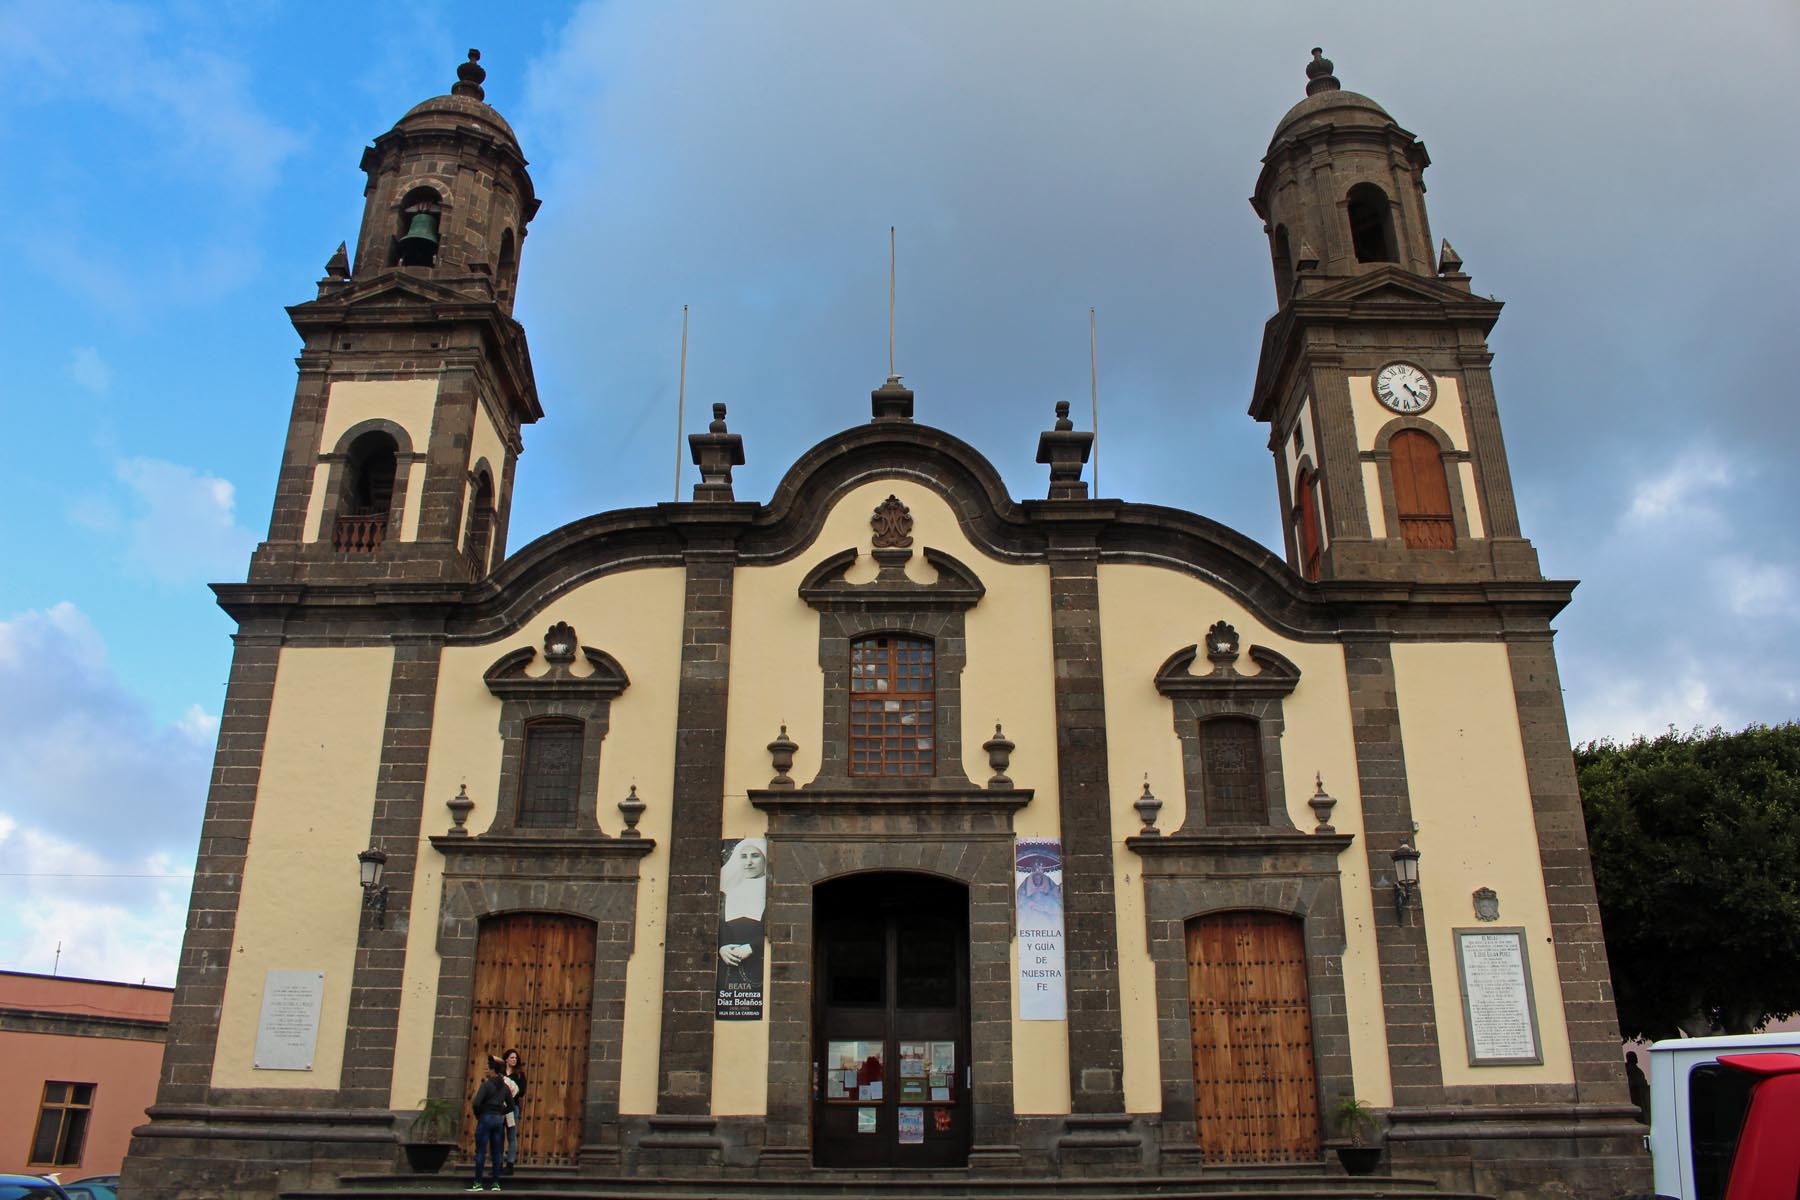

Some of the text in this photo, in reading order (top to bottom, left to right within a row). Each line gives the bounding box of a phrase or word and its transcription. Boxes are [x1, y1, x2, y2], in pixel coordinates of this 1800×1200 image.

[1019, 929, 1062, 938] ESTRELLA
[1027, 941, 1056, 951] Y GUÍA
[1035, 956, 1048, 964] DE
[1021, 969, 1062, 978] NUESTRA
[1036, 982, 1048, 991] FE
[719, 990, 761, 998] Sor Lorenza
[717, 998, 763, 1006] Díaz Bolaños
